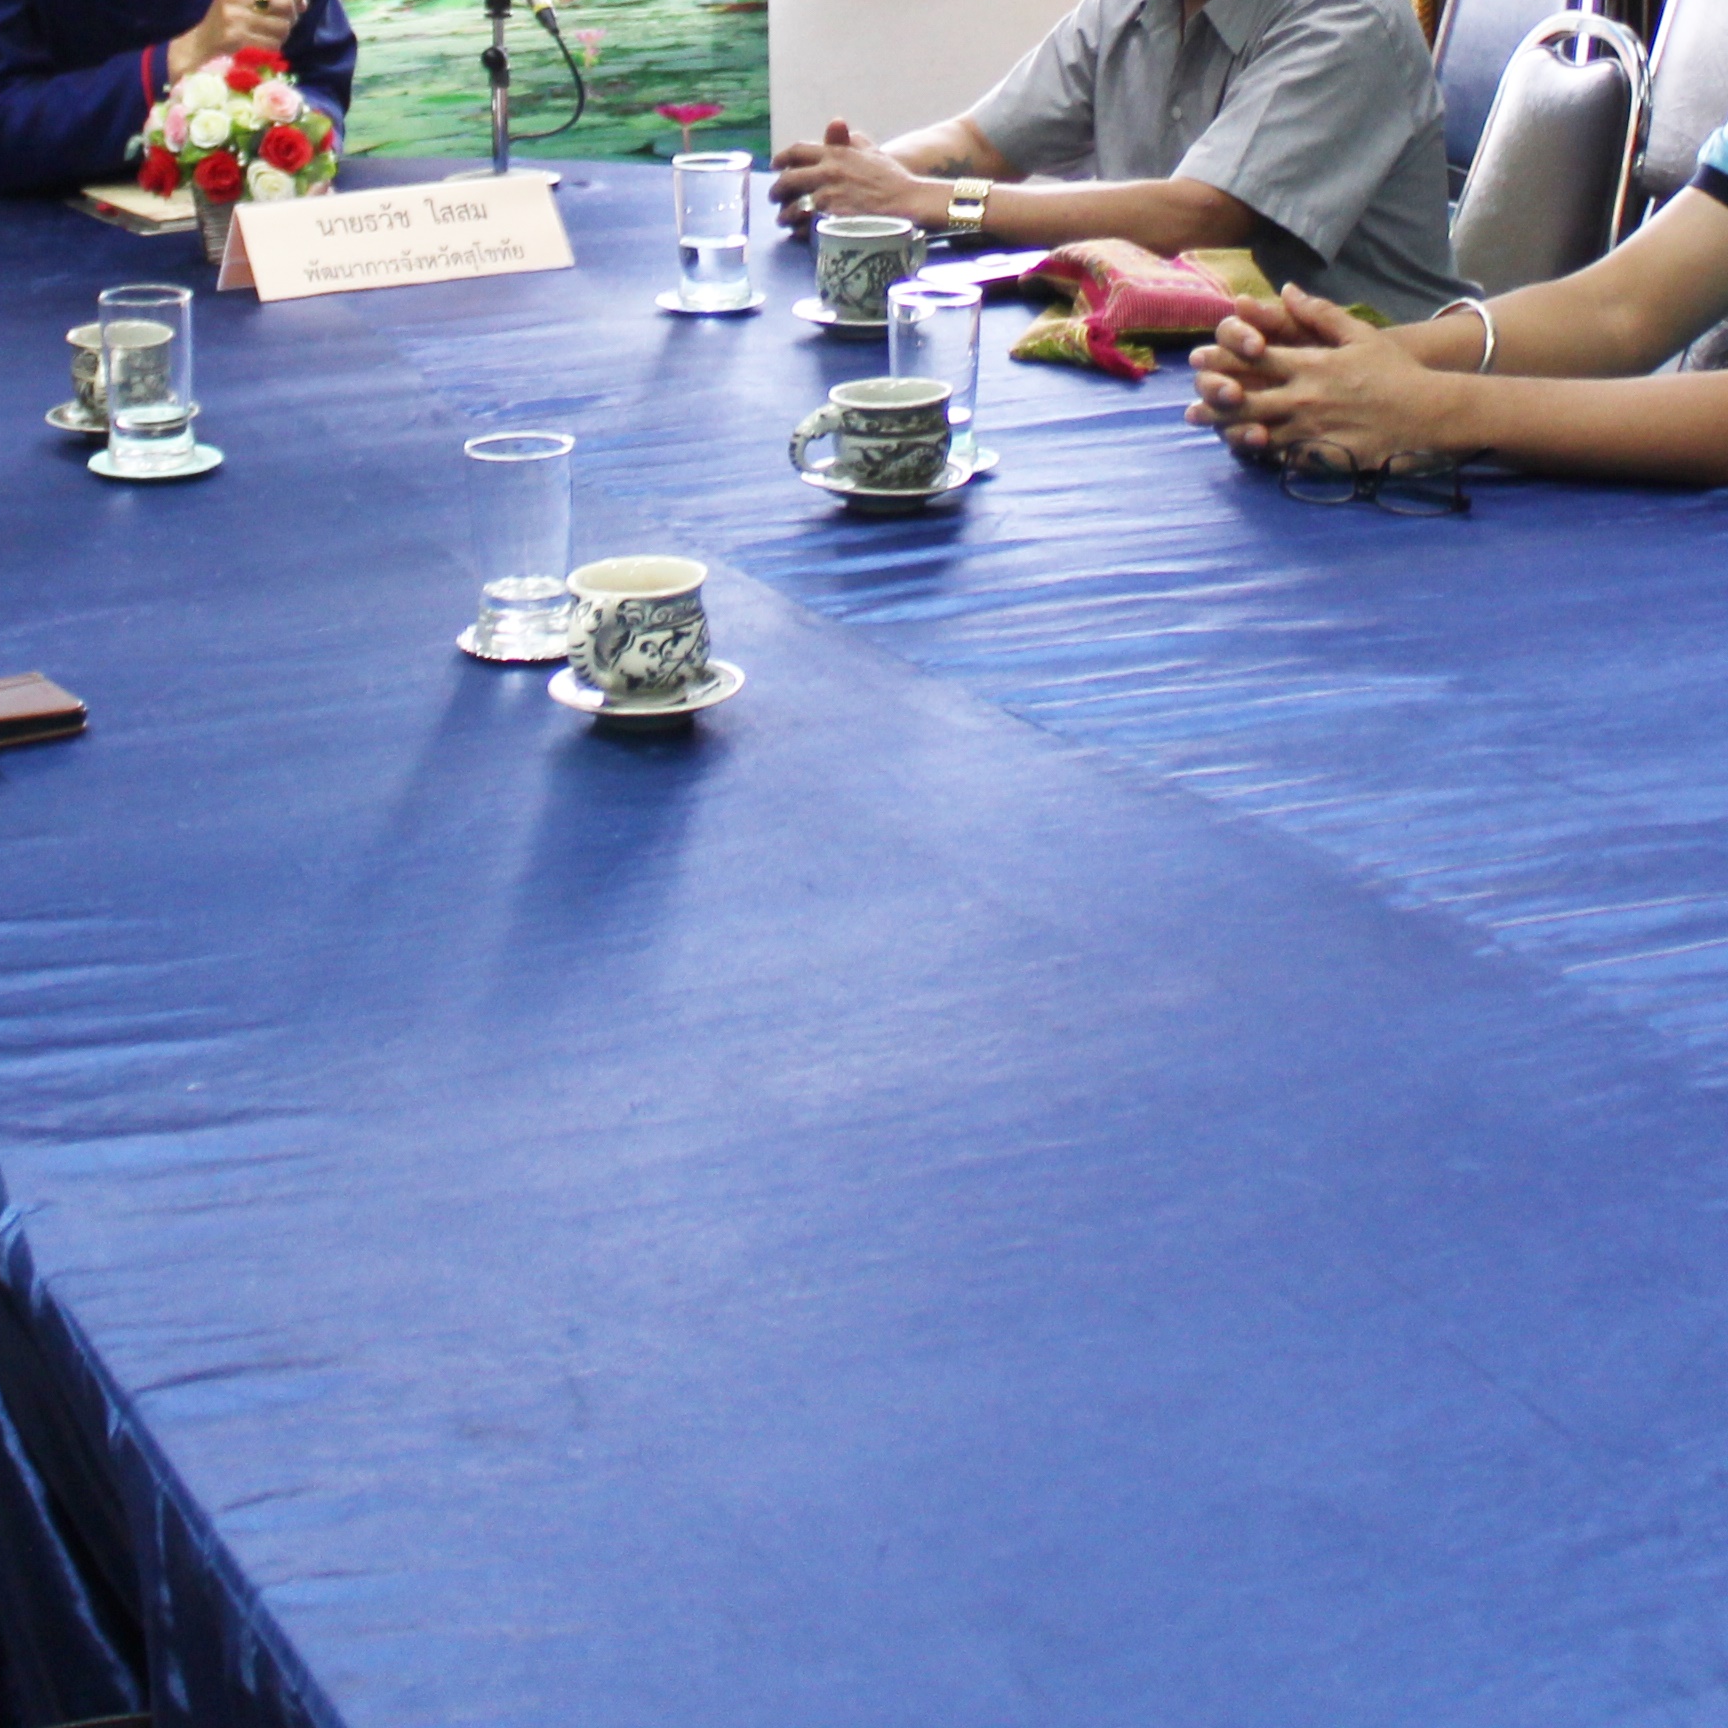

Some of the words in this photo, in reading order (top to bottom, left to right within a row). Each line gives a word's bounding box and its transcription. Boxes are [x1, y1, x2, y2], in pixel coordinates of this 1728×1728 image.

[315, 202, 411, 238] นายธวัช
[303, 238, 526, 283] พัฒนาการจังหวัดสุโขทัย
